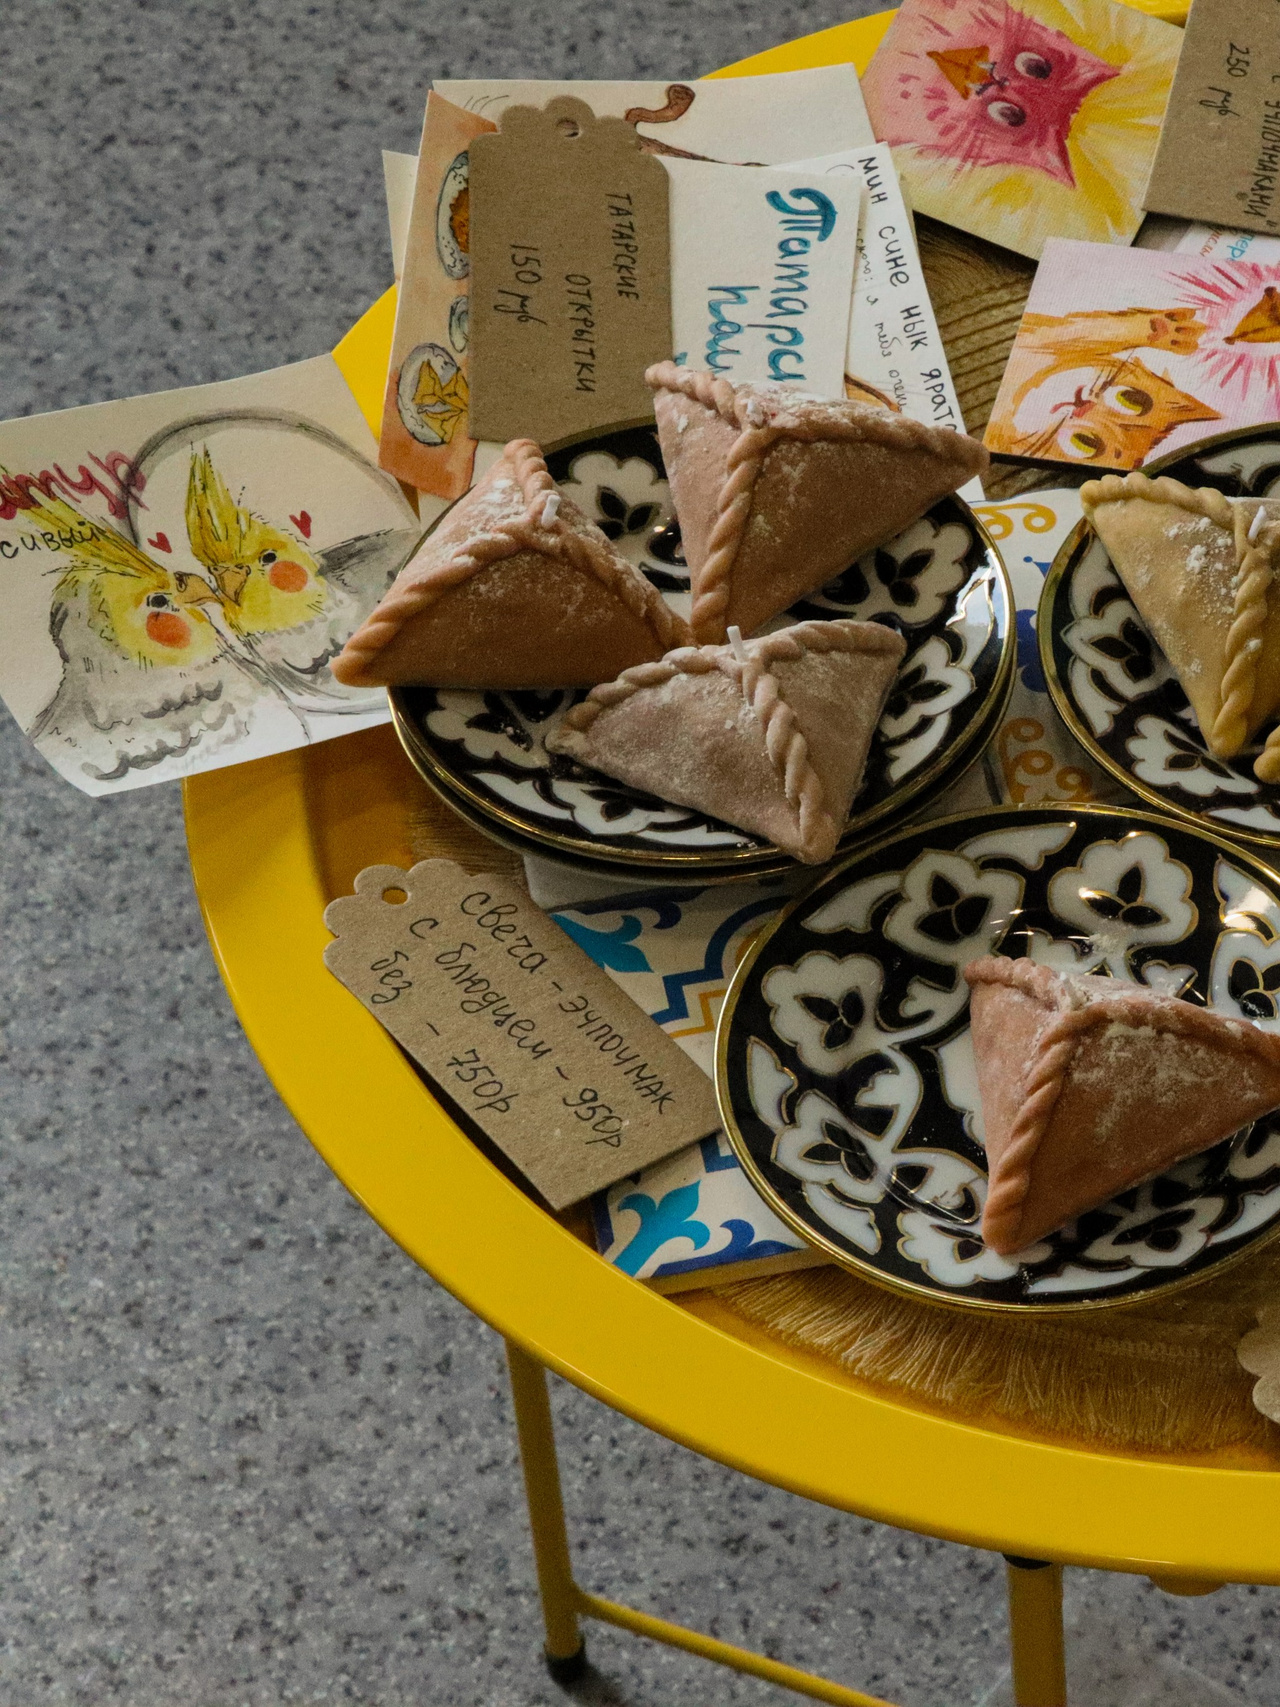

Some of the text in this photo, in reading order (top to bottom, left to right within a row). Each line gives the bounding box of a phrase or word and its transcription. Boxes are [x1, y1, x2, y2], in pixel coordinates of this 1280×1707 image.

[1199, 42, 1250, 118] 250 руб
[492, 243, 549, 326] 150 руб
[604, 192, 640, 301] ТАТАРСКИЕ
[565, 272, 597, 393] ОТКРЫТКИ
[370, 950, 413, 1004] без
[435, 942, 553, 1060] блюдцем
